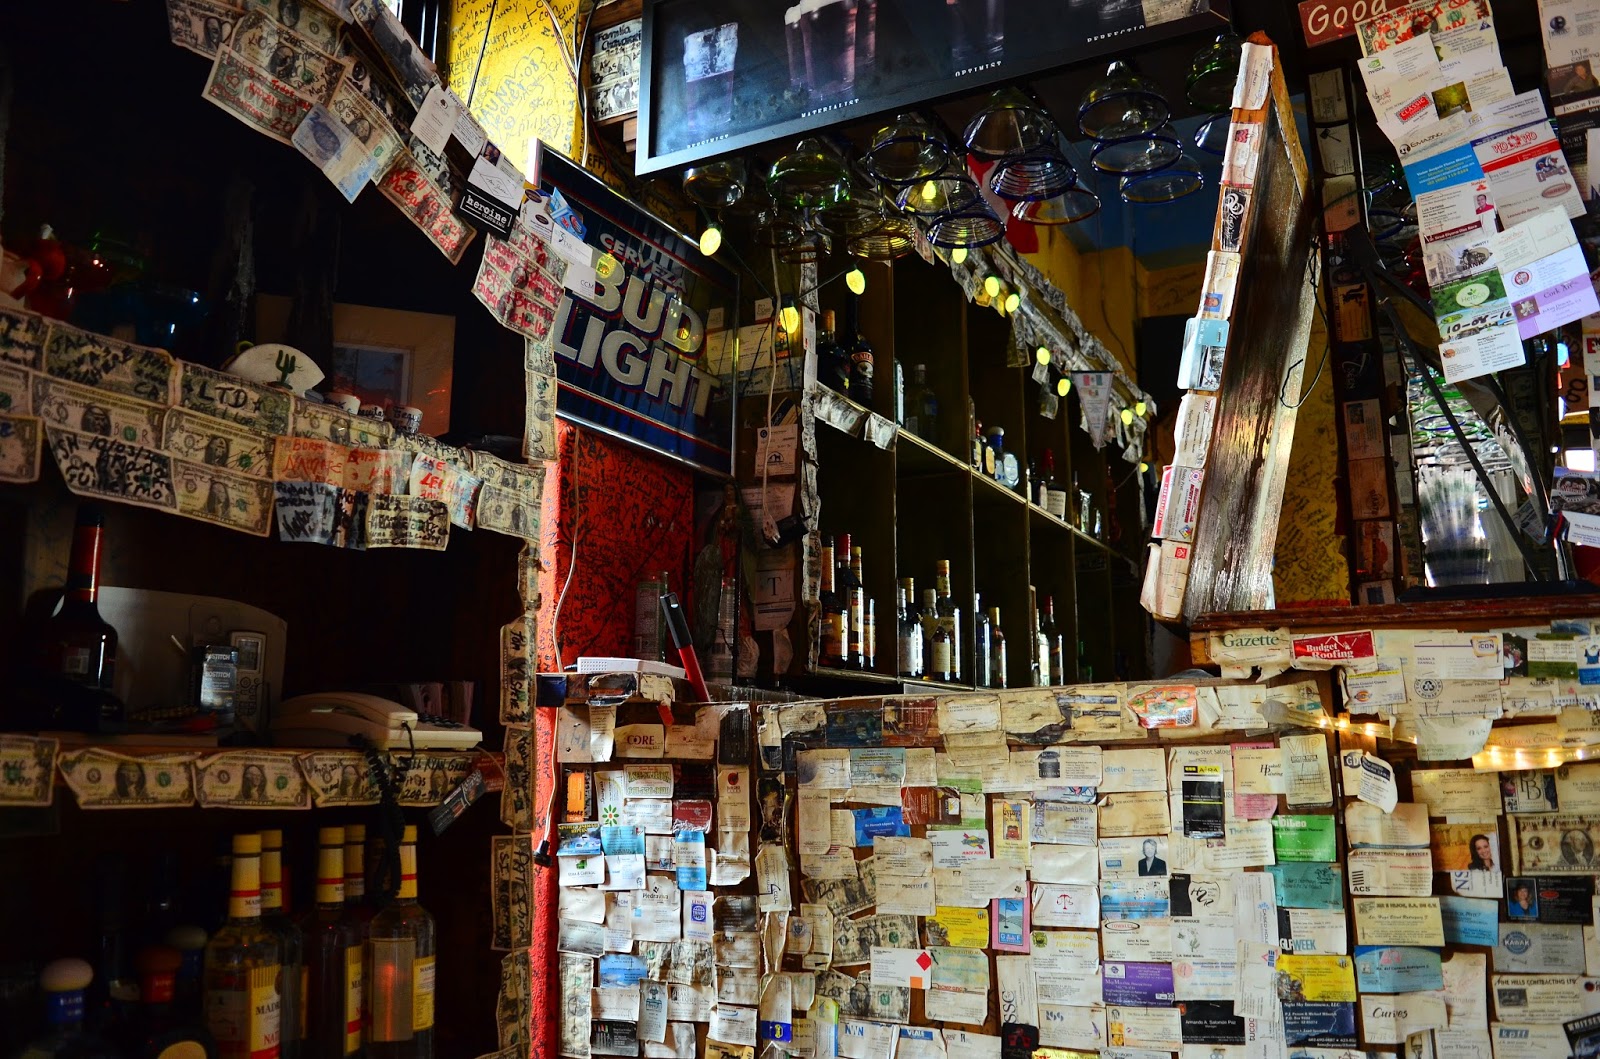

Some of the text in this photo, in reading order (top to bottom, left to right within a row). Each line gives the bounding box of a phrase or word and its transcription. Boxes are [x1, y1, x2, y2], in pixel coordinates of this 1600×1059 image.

[954, 60, 1003, 77] OPTIMIST
[1400, 97, 1427, 117] CLASSIC
[466, 195, 507, 224] heroine
[600, 233, 687, 293] CERVEZA
[588, 244, 706, 353] BUD
[554, 294, 721, 418] LIGHT
[200, 382, 249, 408] LTD
[1223, 634, 1279, 648] Gazette
[1306, 643, 1354, 660] Budget Roofing
[627, 735, 655, 746] CORE
[1285, 737, 1321, 755] VIP
[1372, 1007, 1408, 1019] Curves
